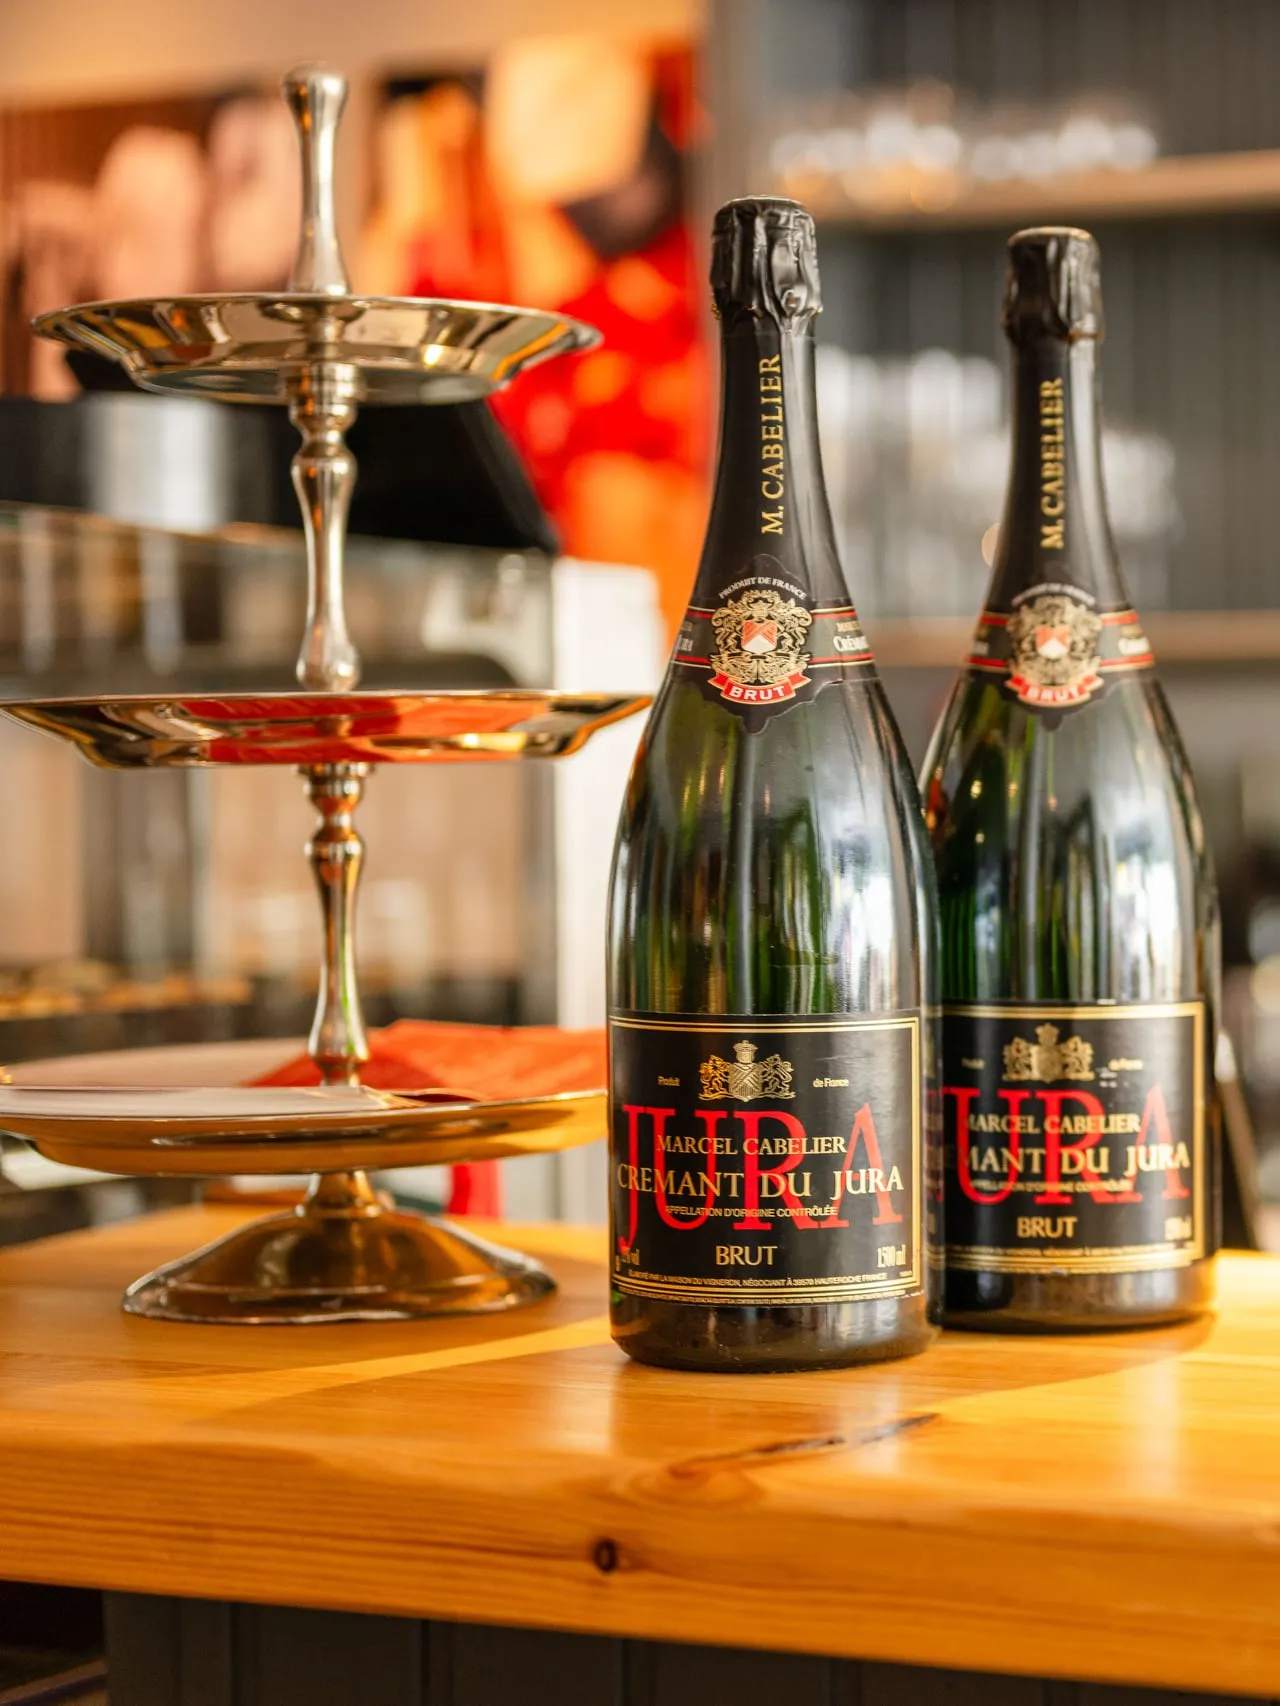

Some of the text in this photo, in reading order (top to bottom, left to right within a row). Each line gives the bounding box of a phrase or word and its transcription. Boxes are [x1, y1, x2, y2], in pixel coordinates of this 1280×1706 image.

[758, 353, 785, 536] M. CABELIER
[1039, 376, 1065, 550] M. CABELIER
[757, 577, 772, 585] DE
[772, 578, 808, 600] FRANCE
[728, 685, 787, 701] BRUT
[1026, 685, 1079, 701] BRUT
[812, 1078, 824, 1088] de
[824, 1077, 850, 1087] France
[1043, 1113, 1142, 1135] CABELIER
[656, 1135, 847, 1156] MARCEL CABELIER
[941, 1081, 1191, 1205] URA
[1060, 1146, 1109, 1174] DU
[1123, 1142, 1191, 1177] JURA
[617, 1163, 904, 1200] CREMANT DU JURA
[618, 1102, 903, 1256] JURA
[723, 1207, 776, 1218] D'ORIGINE
[776, 1204, 838, 1217] CONTRÔLÉE
[1016, 1216, 1078, 1239] BRUT
[715, 1244, 778, 1267] BRUT
